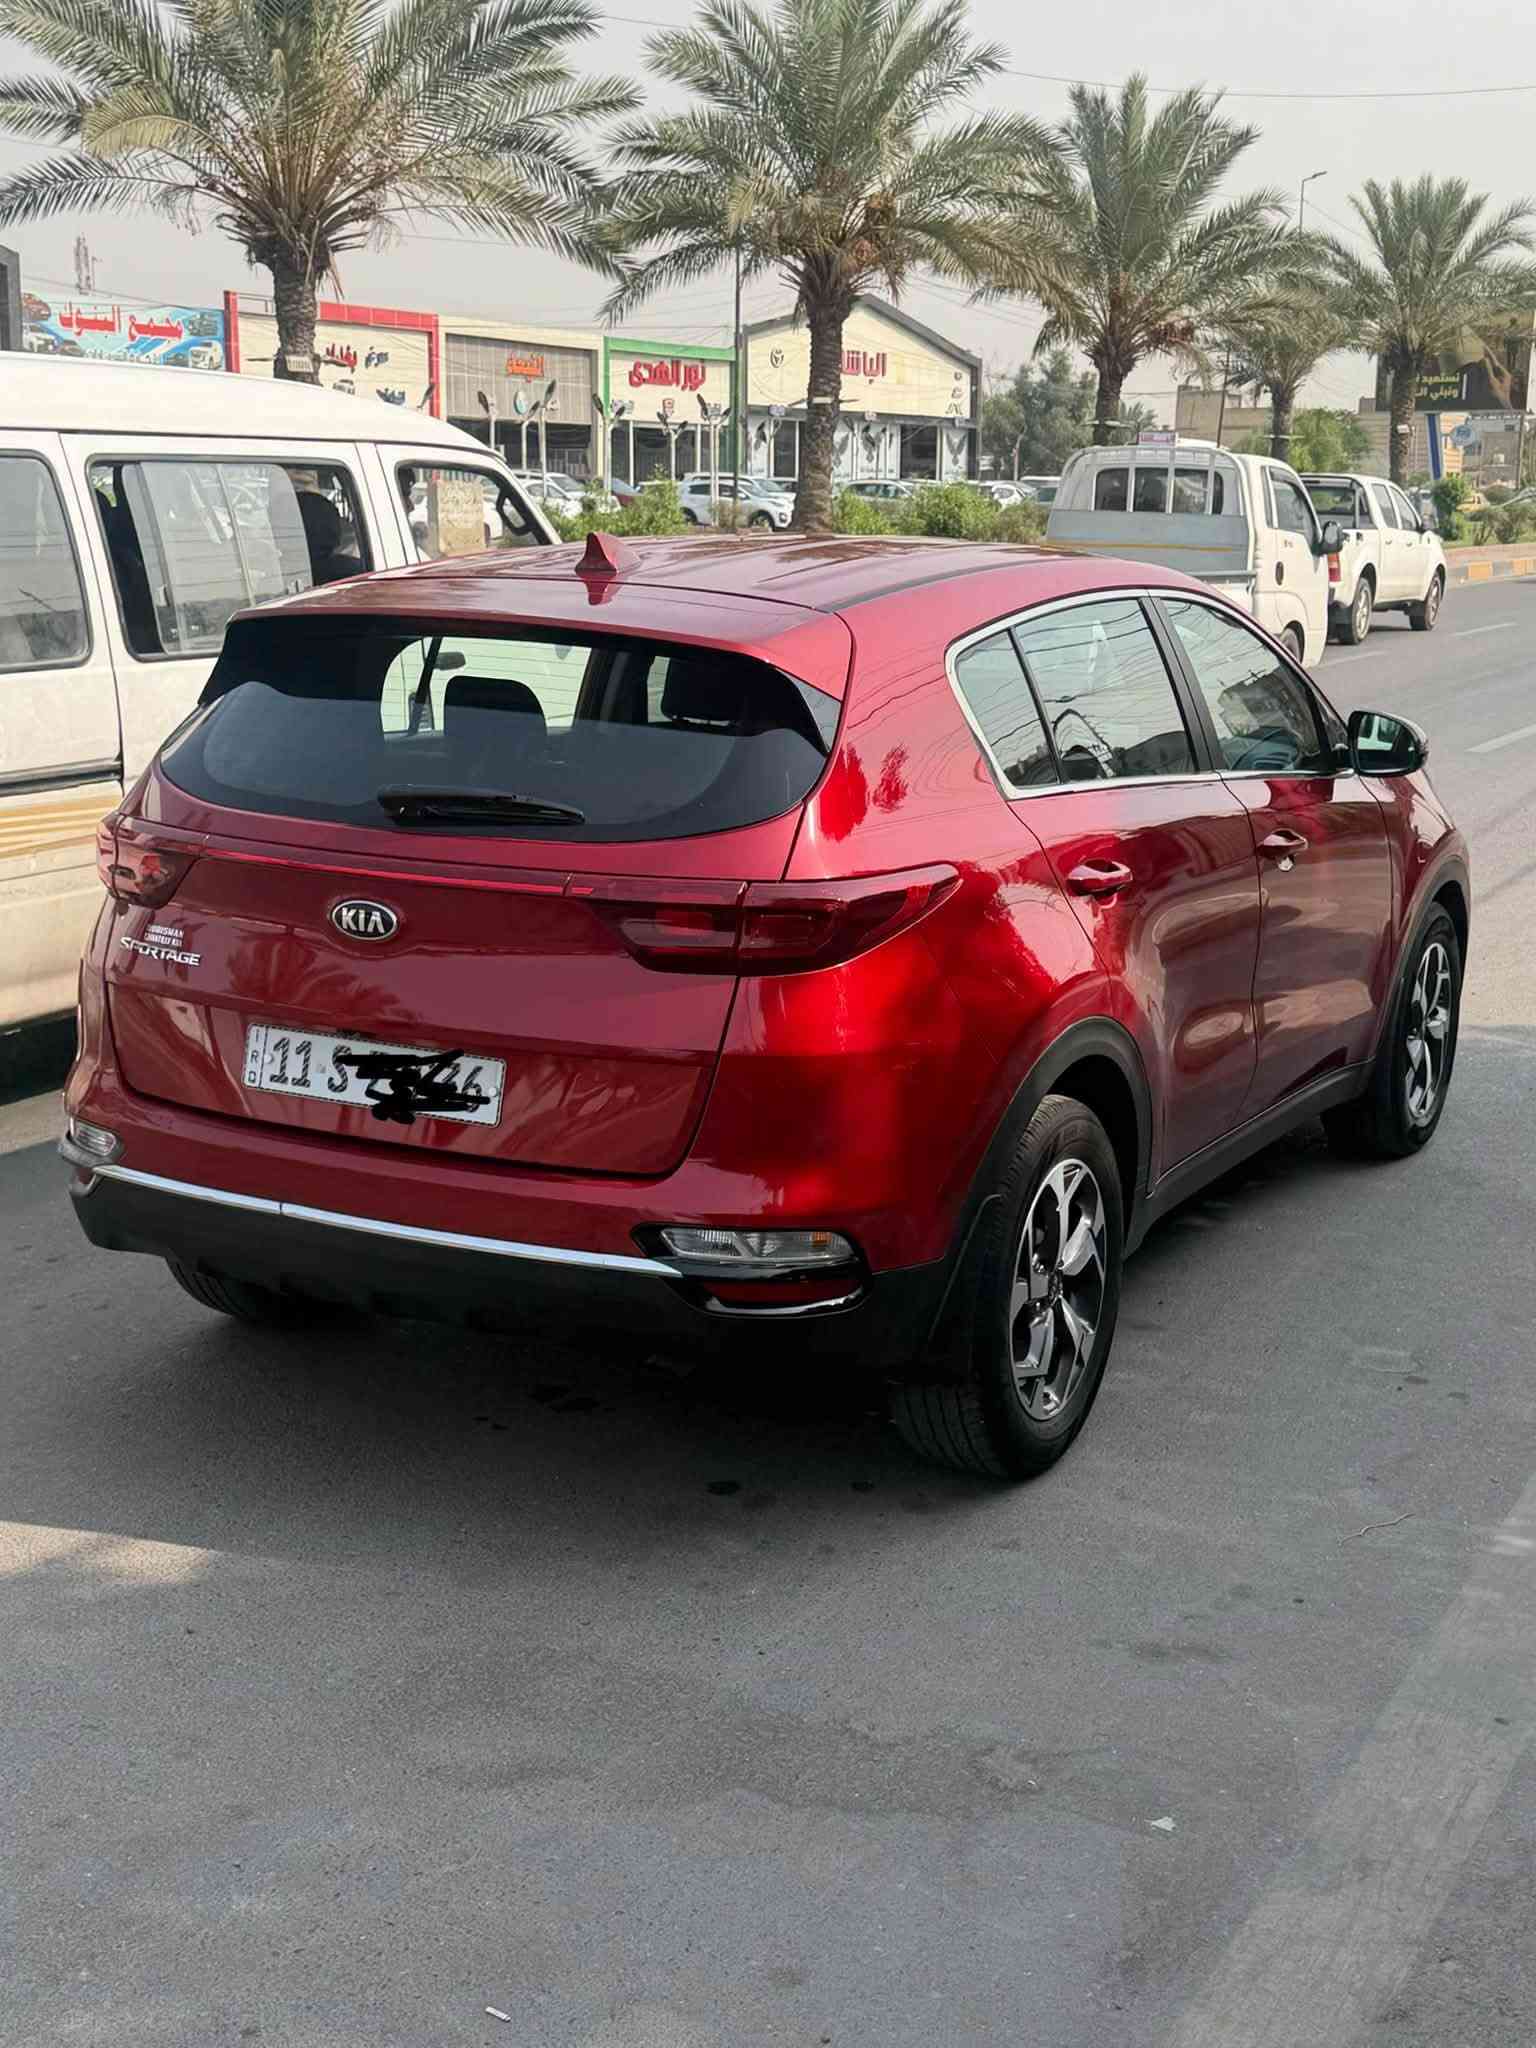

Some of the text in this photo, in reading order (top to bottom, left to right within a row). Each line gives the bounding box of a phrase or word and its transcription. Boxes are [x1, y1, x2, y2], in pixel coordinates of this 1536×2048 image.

[628, 359, 706, 391] نور الهدى
[341, 905, 387, 935] KIA
[119, 936, 201, 966] SPORTAGE
[269, 1037, 312, 1089] 11
